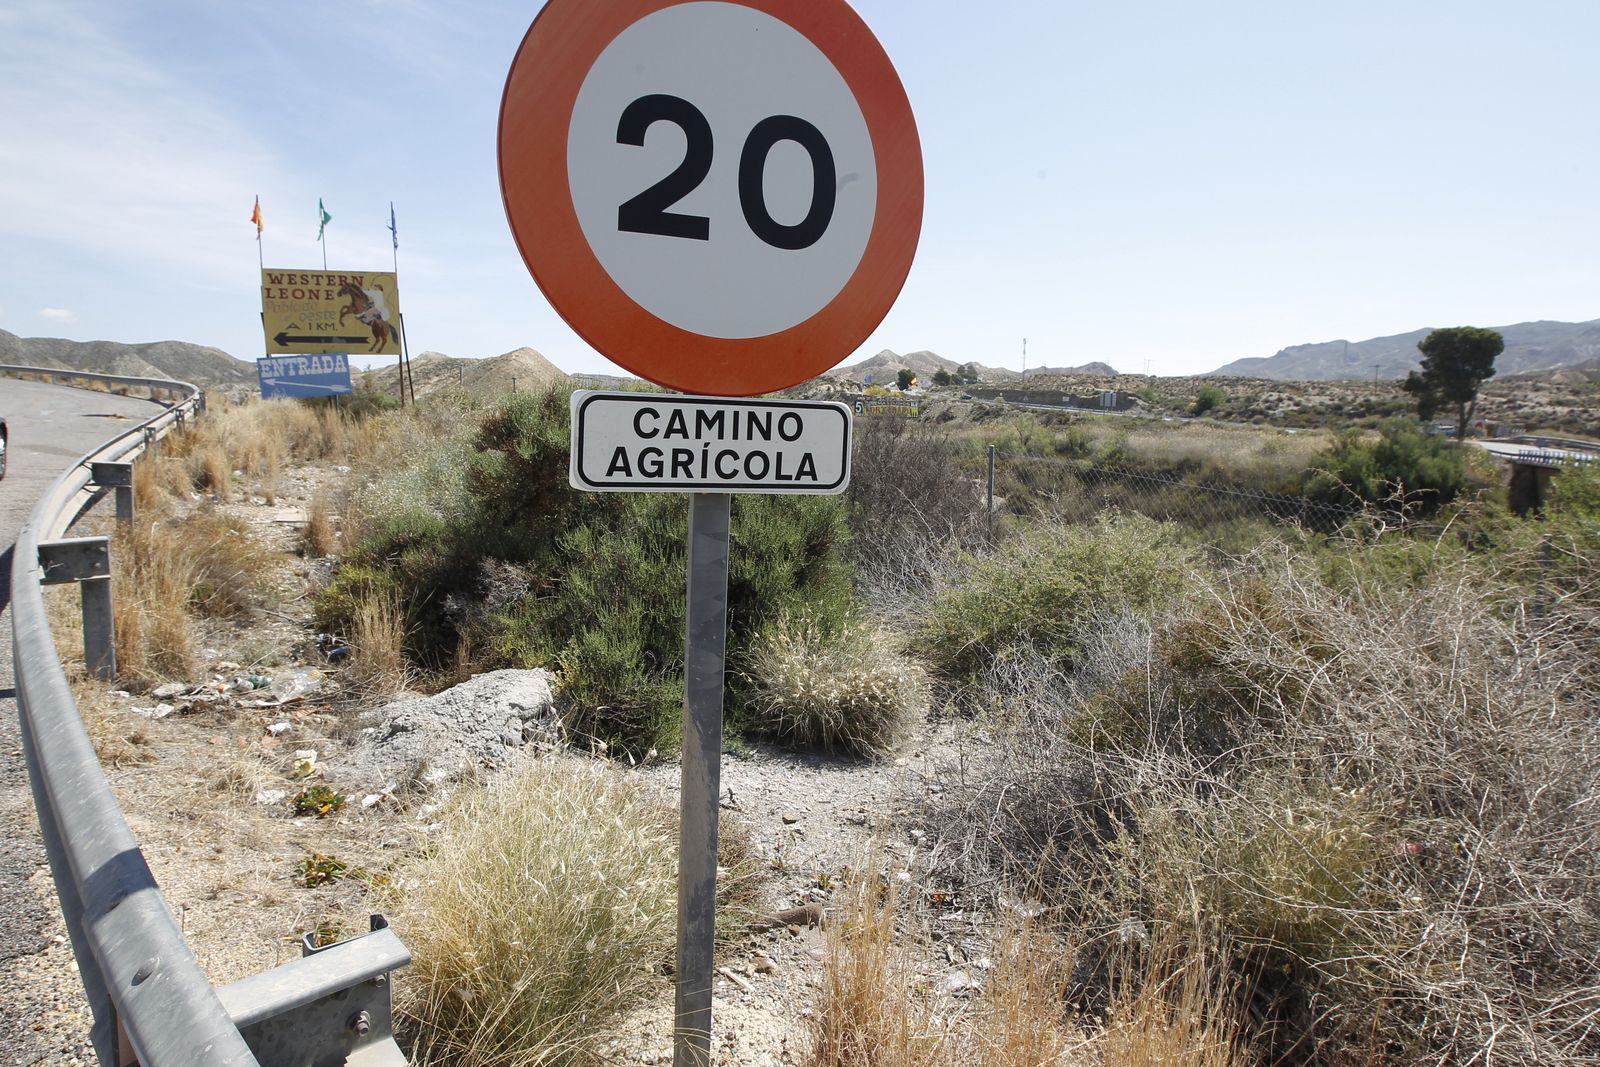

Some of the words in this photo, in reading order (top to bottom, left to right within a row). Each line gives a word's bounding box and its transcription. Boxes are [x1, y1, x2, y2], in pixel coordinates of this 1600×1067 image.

[616, 93, 837, 250] 20
[265, 287, 335, 301] LEONE
[266, 273, 365, 287] WESTERN
[259, 355, 348, 378] ENTRADA
[633, 407, 804, 442] CAMINO
[605, 442, 818, 482] AGRÍCOLA
